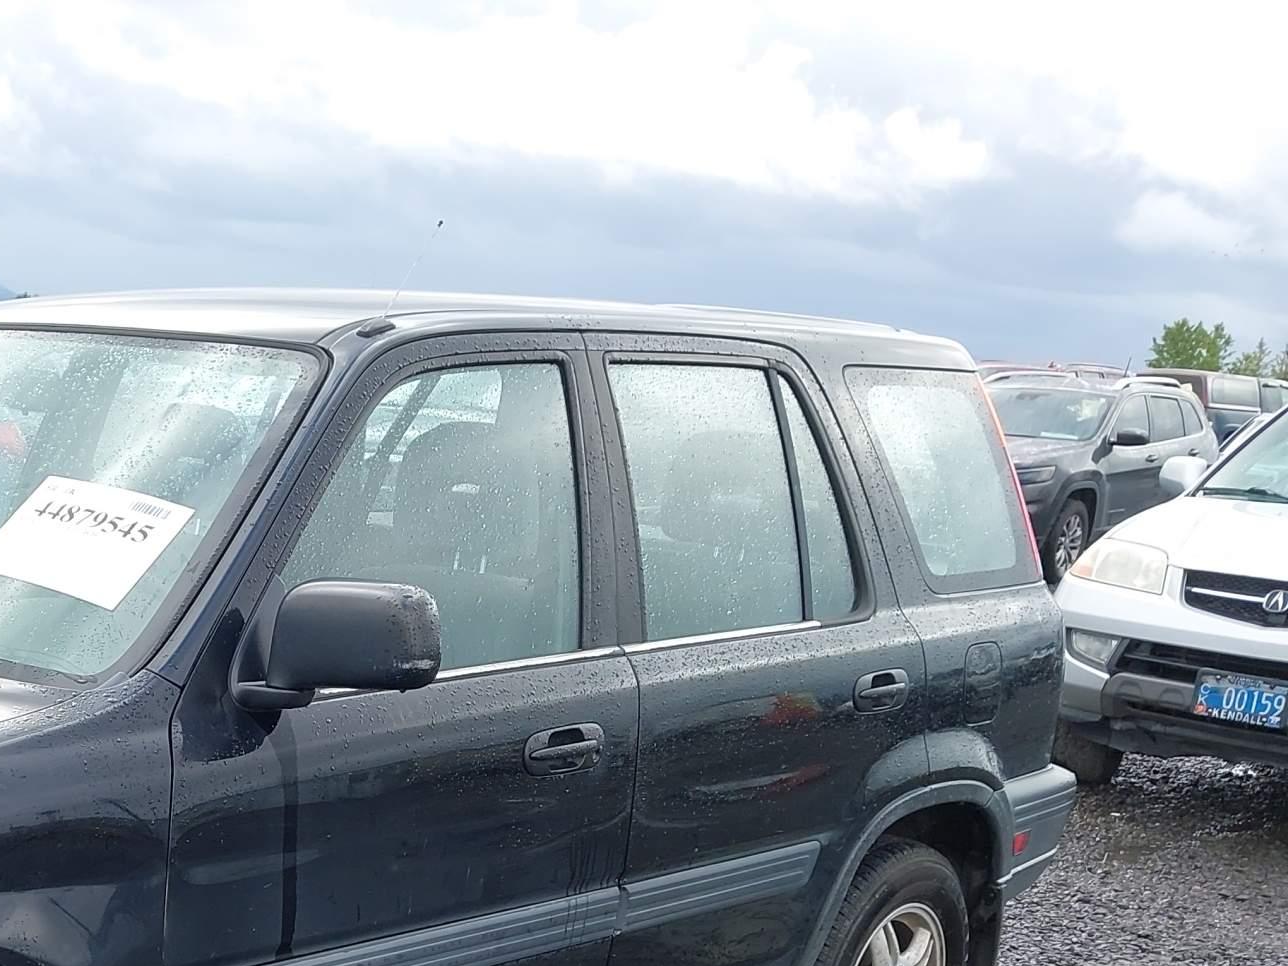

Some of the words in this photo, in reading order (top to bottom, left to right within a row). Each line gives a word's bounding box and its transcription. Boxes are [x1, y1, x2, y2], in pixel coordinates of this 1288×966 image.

[35, 501, 155, 542] 44879545
[1211, 708, 1263, 725] KENDALL
[1222, 687, 1287, 717] 00159
